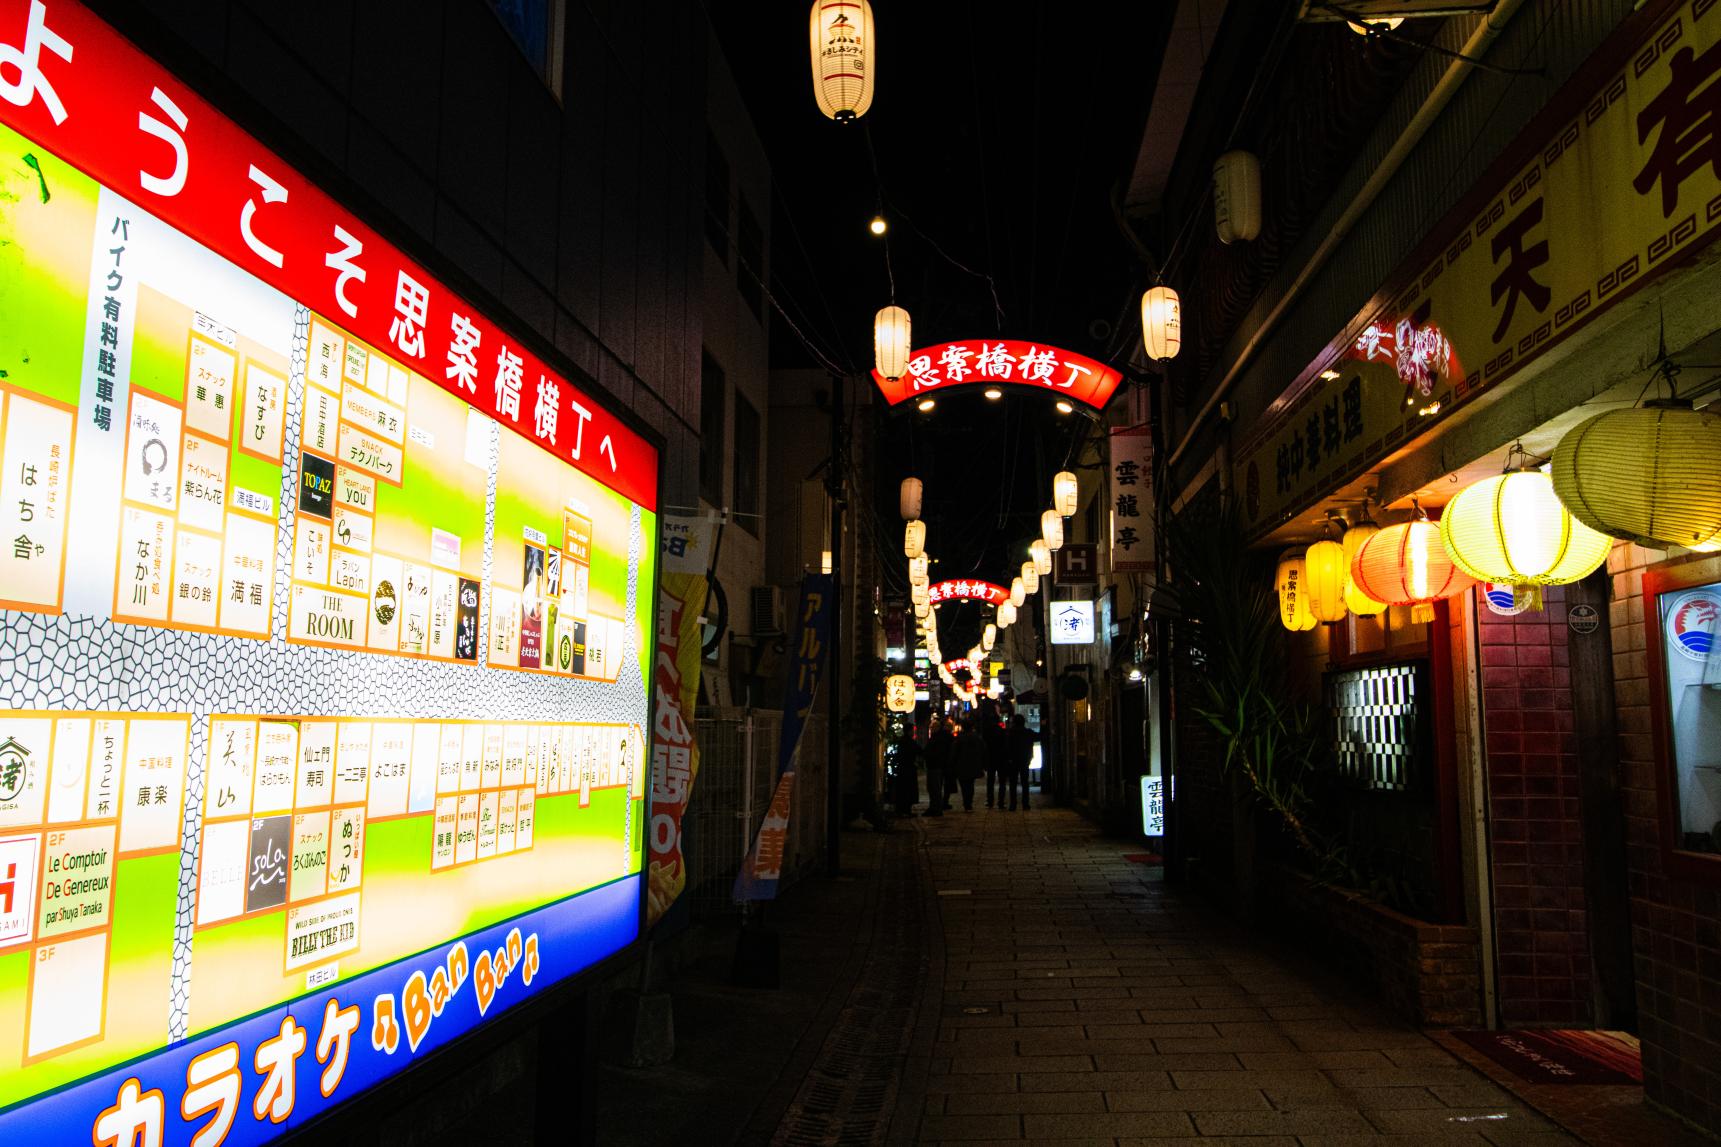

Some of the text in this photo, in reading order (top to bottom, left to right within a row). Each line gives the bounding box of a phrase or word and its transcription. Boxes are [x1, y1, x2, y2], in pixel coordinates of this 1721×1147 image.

[93, 216, 130, 432] バイク有料駐車場
[198, 367, 226, 386] スナック
[907, 343, 1092, 390] 思案橋横丁
[255, 385, 268, 441] なすび
[361, 439, 383, 456] SNACK
[187, 462, 223, 483] ナイトルーム
[304, 471, 332, 494] TOPAZ
[150, 482, 173, 503] まろ
[346, 487, 367, 506] you
[1115, 460, 1140, 550] 雲龍亭
[133, 539, 150, 606] なか川
[336, 570, 364, 590] Lapin
[179, 582, 212, 603] 銀の鈴
[231, 579, 264, 606] 満福
[323, 595, 343, 612] THE
[306, 612, 354, 640] ROOM
[97, 736, 115, 815] ちょっと一杯
[306, 770, 325, 788] 寿司
[374, 763, 407, 779] よこはま
[136, 785, 168, 807] 康楽
[252, 820, 265, 832] 2F
[48, 833, 66, 846] 2F
[300, 832, 323, 845] スナック
[48, 848, 108, 873] Le Comptoir
[46, 876, 110, 900] De Genereux
[45, 901, 102, 928] par Shuya Tanaka
[291, 921, 354, 958] BILLY THE KID
[39, 946, 56, 962] 3F
[92, 997, 361, 1147] カラオケ
